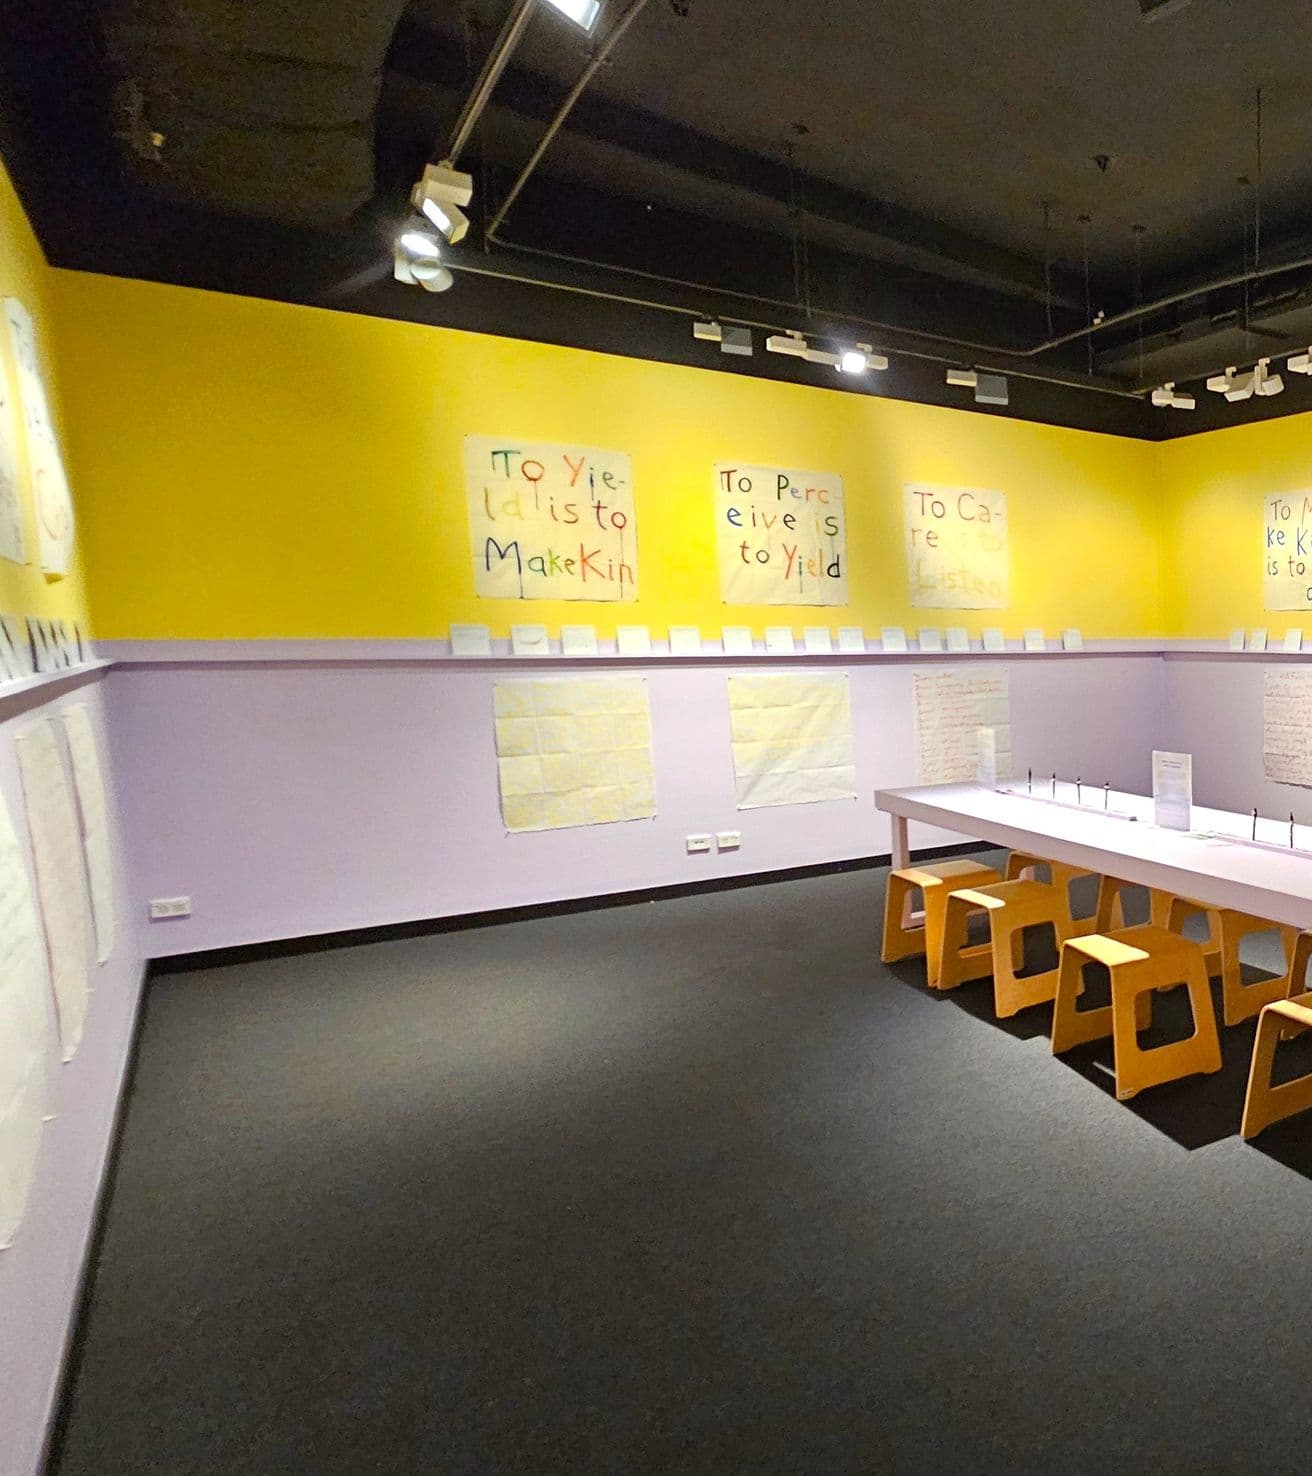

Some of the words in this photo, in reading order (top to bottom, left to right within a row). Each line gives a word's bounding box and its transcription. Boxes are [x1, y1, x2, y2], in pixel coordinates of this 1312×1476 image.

[491, 450, 545, 482] To
[563, 454, 626, 492] Yie-
[720, 469, 753, 494] To
[484, 487, 525, 521] ld
[549, 497, 580, 524] is
[591, 500, 627, 530] to
[727, 505, 797, 531] eive
[815, 512, 839, 538] is
[912, 491, 946, 519] To
[957, 493, 1002, 524] Ca-
[1270, 499, 1291, 521] To
[910, 526, 939, 549] re
[1267, 526, 1285, 548] ke
[739, 541, 770, 565] to
[782, 543, 841, 581] Yield
[1267, 556, 1279, 576] is
[1288, 555, 1306, 578] to
